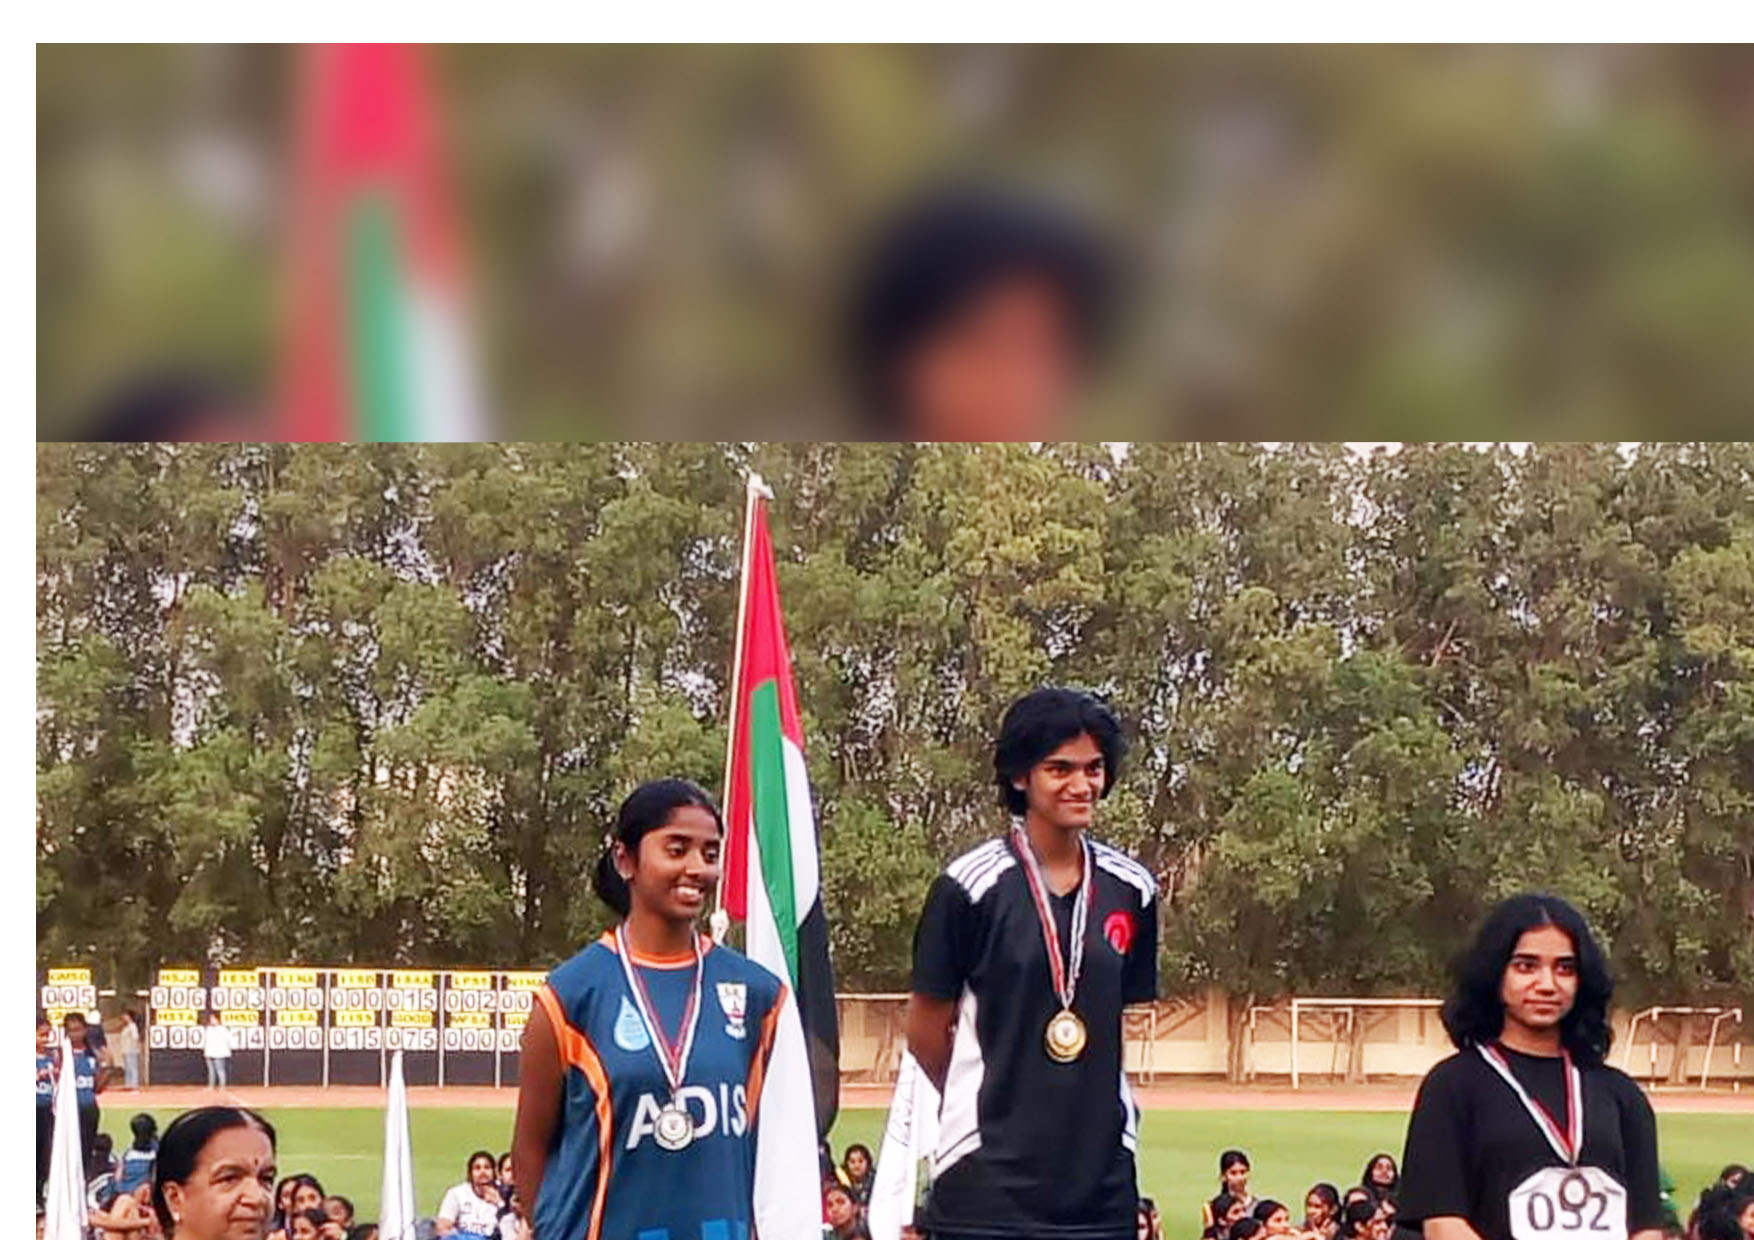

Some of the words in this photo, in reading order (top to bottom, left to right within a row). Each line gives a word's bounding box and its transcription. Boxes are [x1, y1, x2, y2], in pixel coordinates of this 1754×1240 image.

[46, 988, 94, 1008] 005
[154, 988, 205, 1007] 006
[215, 990, 263, 1008] 003
[273, 990, 321, 1007] 000
[333, 990, 380, 1007] 000
[389, 992, 435, 1009] 015
[449, 992, 496, 1009] 002
[502, 994, 529, 1009] 00
[152, 1028, 203, 1046] 000
[273, 1030, 320, 1046] 000
[334, 1030, 378, 1047] 015
[389, 1031, 435, 1048] 075
[447, 1032, 492, 1048] 000
[625, 1082, 747, 1149] ADIS
